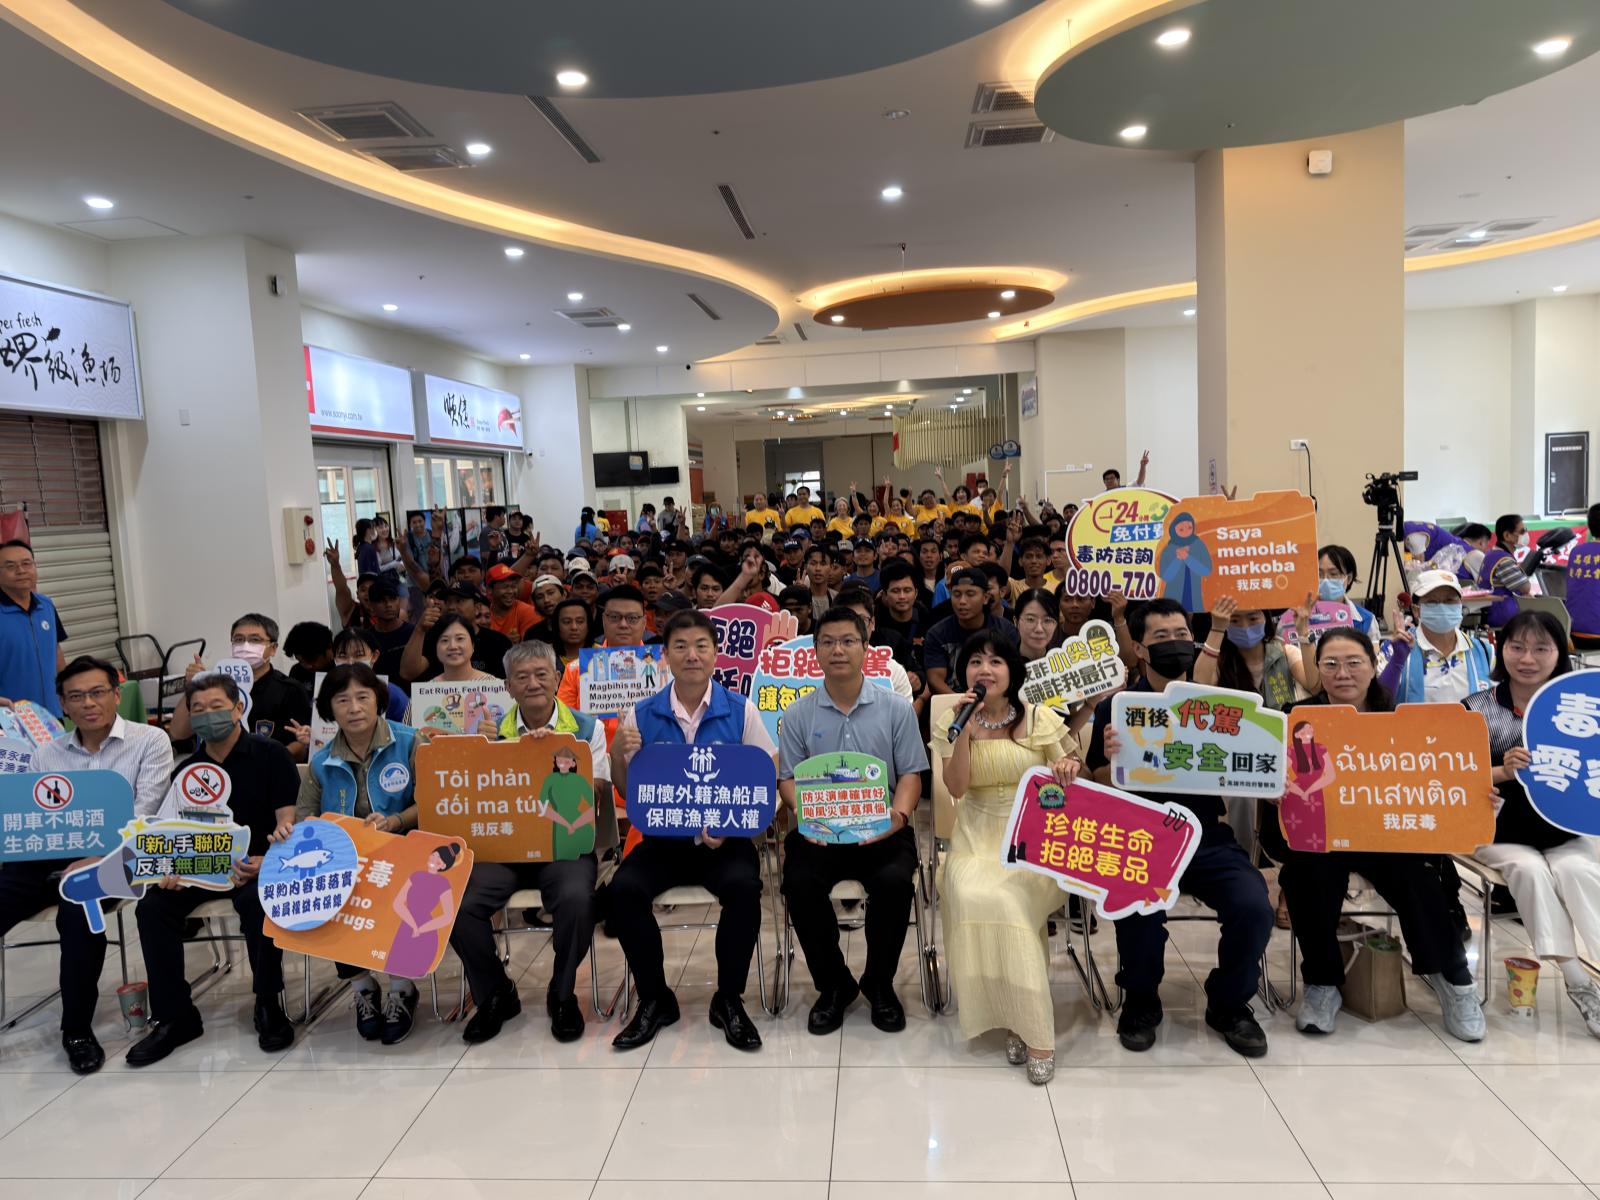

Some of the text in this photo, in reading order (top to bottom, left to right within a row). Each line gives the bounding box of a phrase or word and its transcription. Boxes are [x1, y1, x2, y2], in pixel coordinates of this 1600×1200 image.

[16, 312, 42, 329] fresh
[1114, 500, 1139, 523] 24
[1216, 527, 1262, 542] Saya
[1077, 546, 1153, 565] 毒防諮詢
[1217, 541, 1298, 558] menolak
[1218, 560, 1295, 576] narkoba
[1236, 578, 1273, 592] 我反毒
[217, 665, 249, 676] 1955
[760, 647, 893, 678] 拒絕駕
[419, 687, 434, 695] Eat
[435, 686, 460, 695] Right,
[462, 685, 479, 693] Feel
[589, 682, 642, 692] Magbihis ng
[589, 690, 657, 702] Maayos, Ipakita
[1336, 736, 1478, 772] ฉันต่อต้าน
[435, 768, 531, 791] Tôi phản
[638, 784, 769, 806] 關懷外籍漁船員
[802, 787, 884, 804] 防災演練確實好
[1339, 779, 1467, 805] ยาเสพติด
[435, 794, 549, 817] đối ma túy
[3, 808, 105, 832] 開車不喝酒
[645, 808, 760, 829] 保障漁業人權
[1383, 813, 1437, 831] 我反毒
[471, 822, 514, 836] 我反毒
[1043, 812, 1154, 856] 珍惜生命
[3, 831, 105, 854] 生命更長久
[135, 855, 232, 876] 反毒無國界
[1040, 838, 1149, 884] 拒絕毒品
[263, 870, 353, 900] 契約內容要落實
[350, 896, 372, 909] no
[334, 912, 375, 931] rugs
